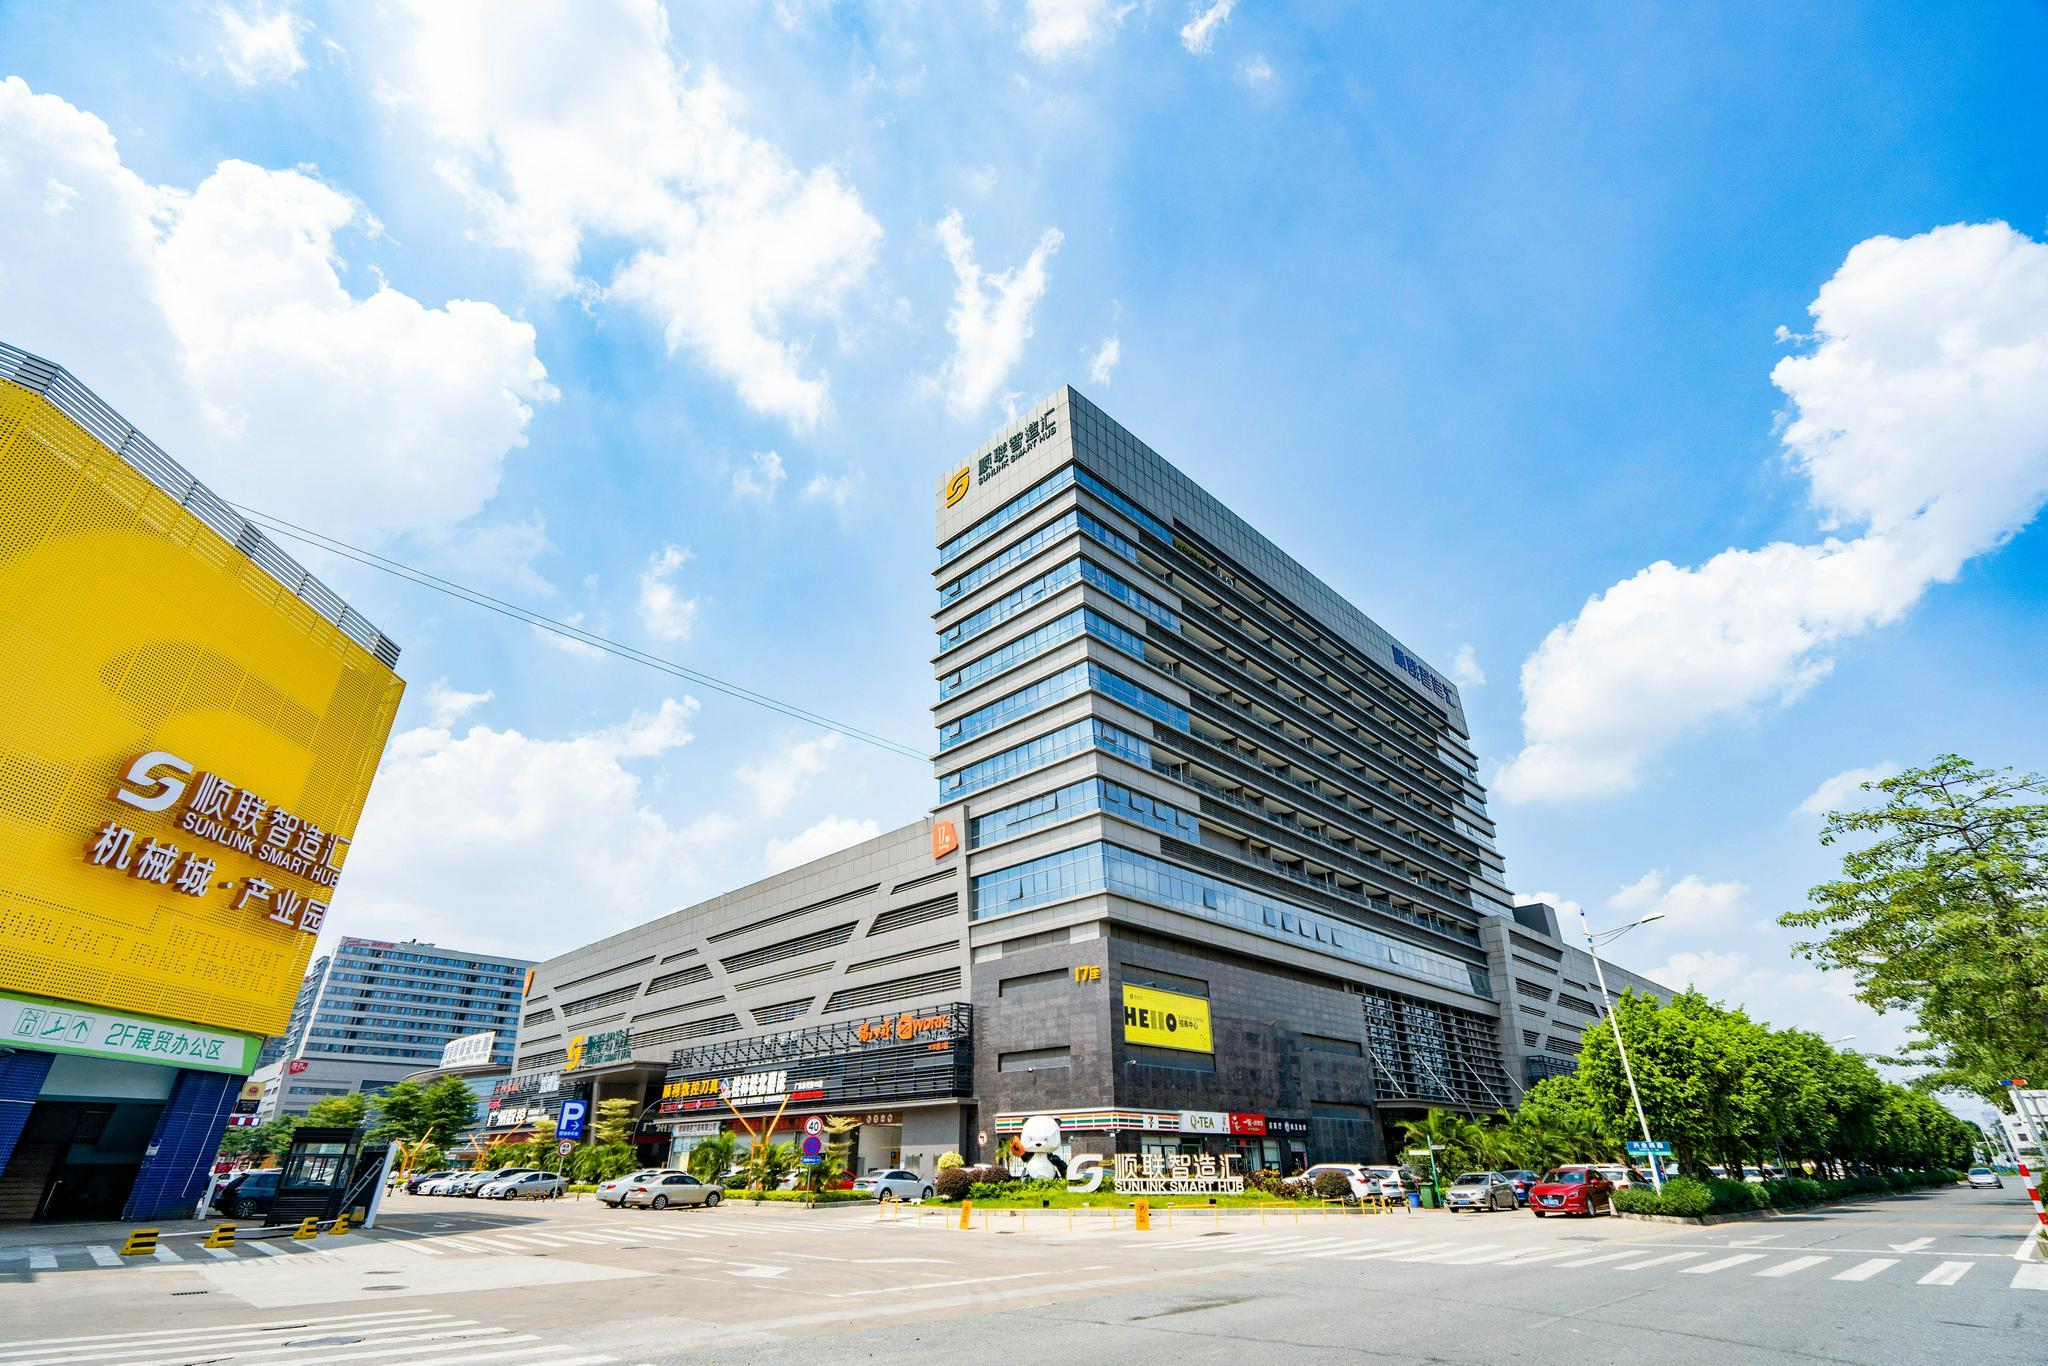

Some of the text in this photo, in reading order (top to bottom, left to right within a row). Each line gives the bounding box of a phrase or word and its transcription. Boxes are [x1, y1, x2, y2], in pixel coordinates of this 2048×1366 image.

[978, 408, 1056, 476] 顺联智造汇
[978, 426, 1057, 486] SUNLINK SMART HUB
[189, 771, 351, 873] 顺联智造汇
[182, 812, 340, 889] SUNLINK SMART HUB
[1075, 965, 1101, 983] 17座
[104, 1023, 226, 1060] 2F展贸办公区
[560, 1102, 584, 1130] P
[808, 1121, 819, 1132] 40
[1114, 1152, 1244, 1180] 顺联智造汇
[1114, 1180, 1245, 1192] SUNLINK SMART HUB
